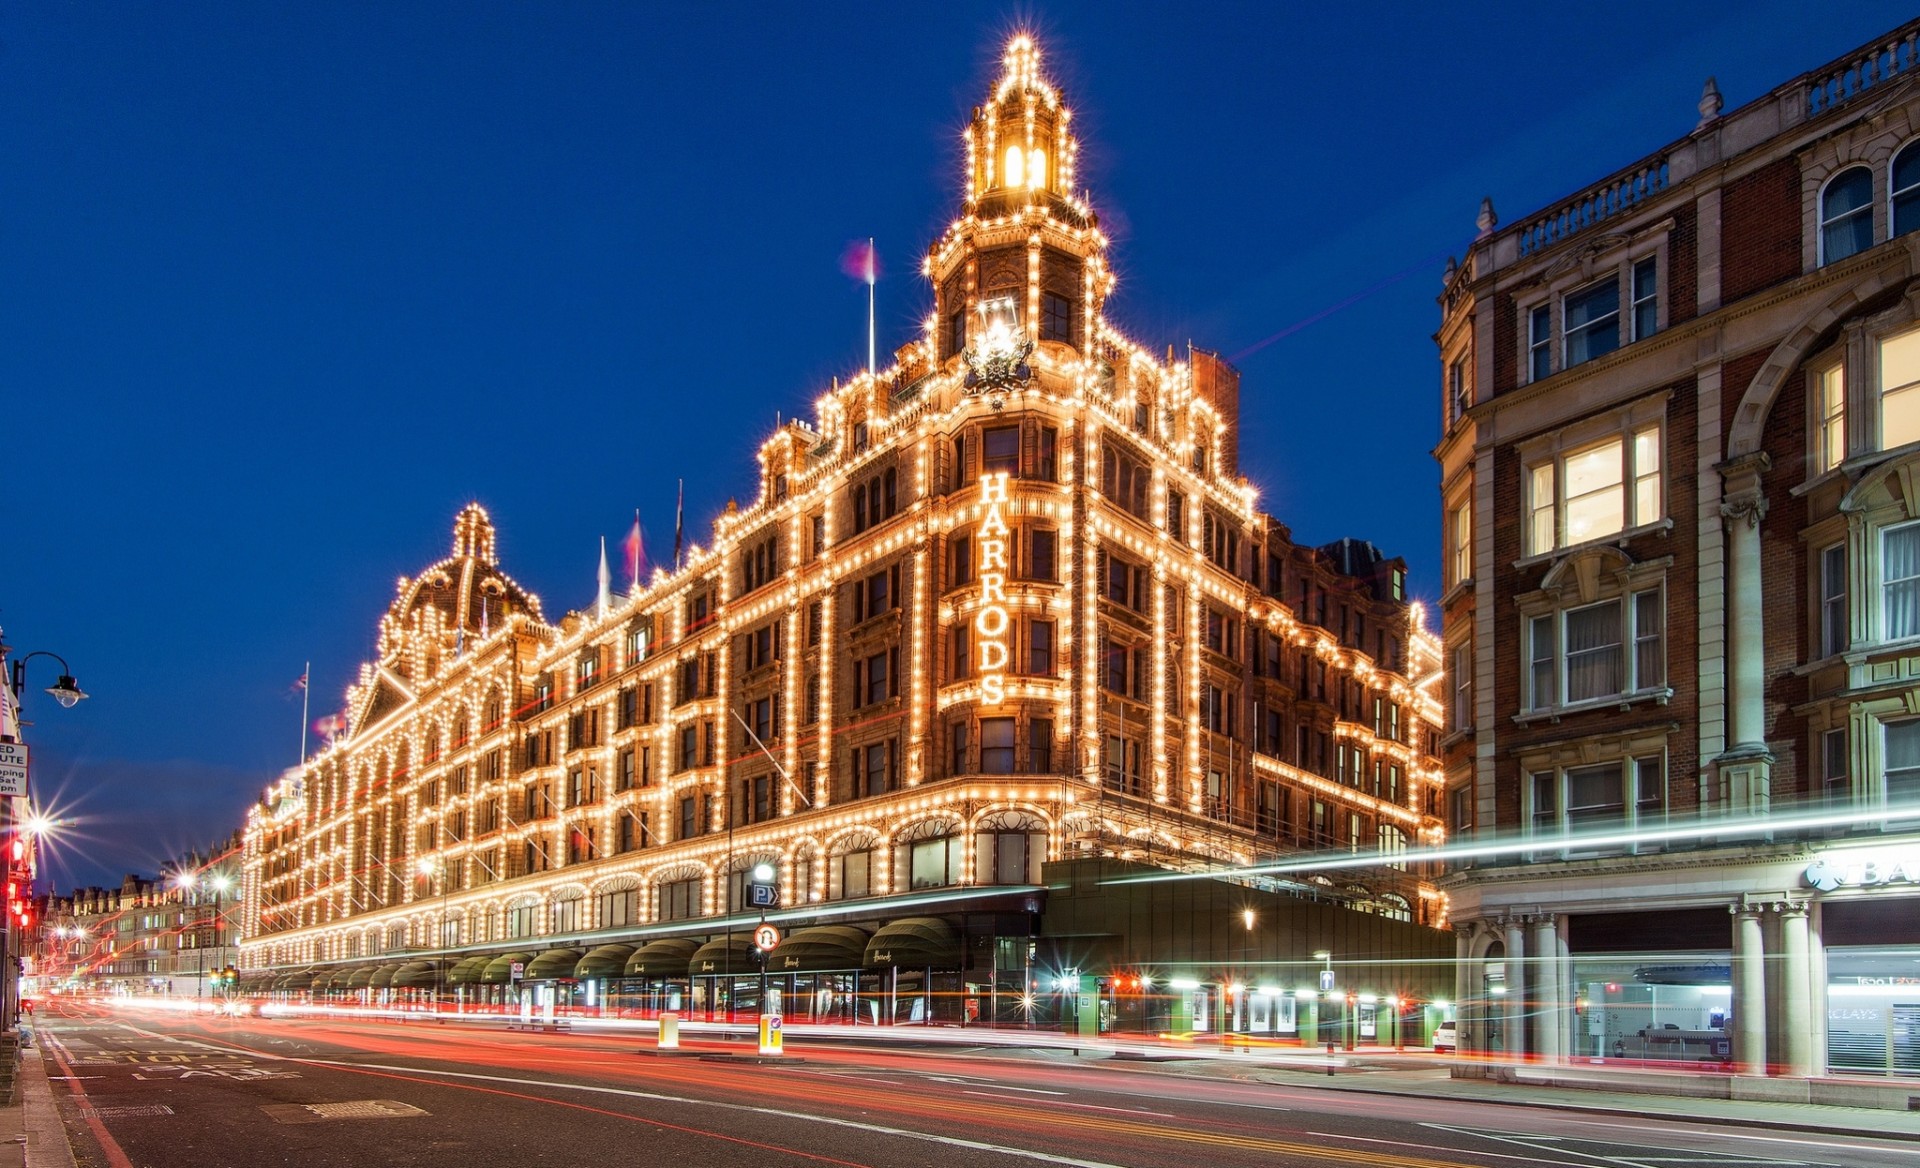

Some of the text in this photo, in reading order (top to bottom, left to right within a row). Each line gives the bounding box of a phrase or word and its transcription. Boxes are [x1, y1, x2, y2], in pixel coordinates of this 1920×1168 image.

[977, 472, 1009, 706] HARRODS
[1860, 859, 1920, 887] BA
[756, 887, 766, 901] P
